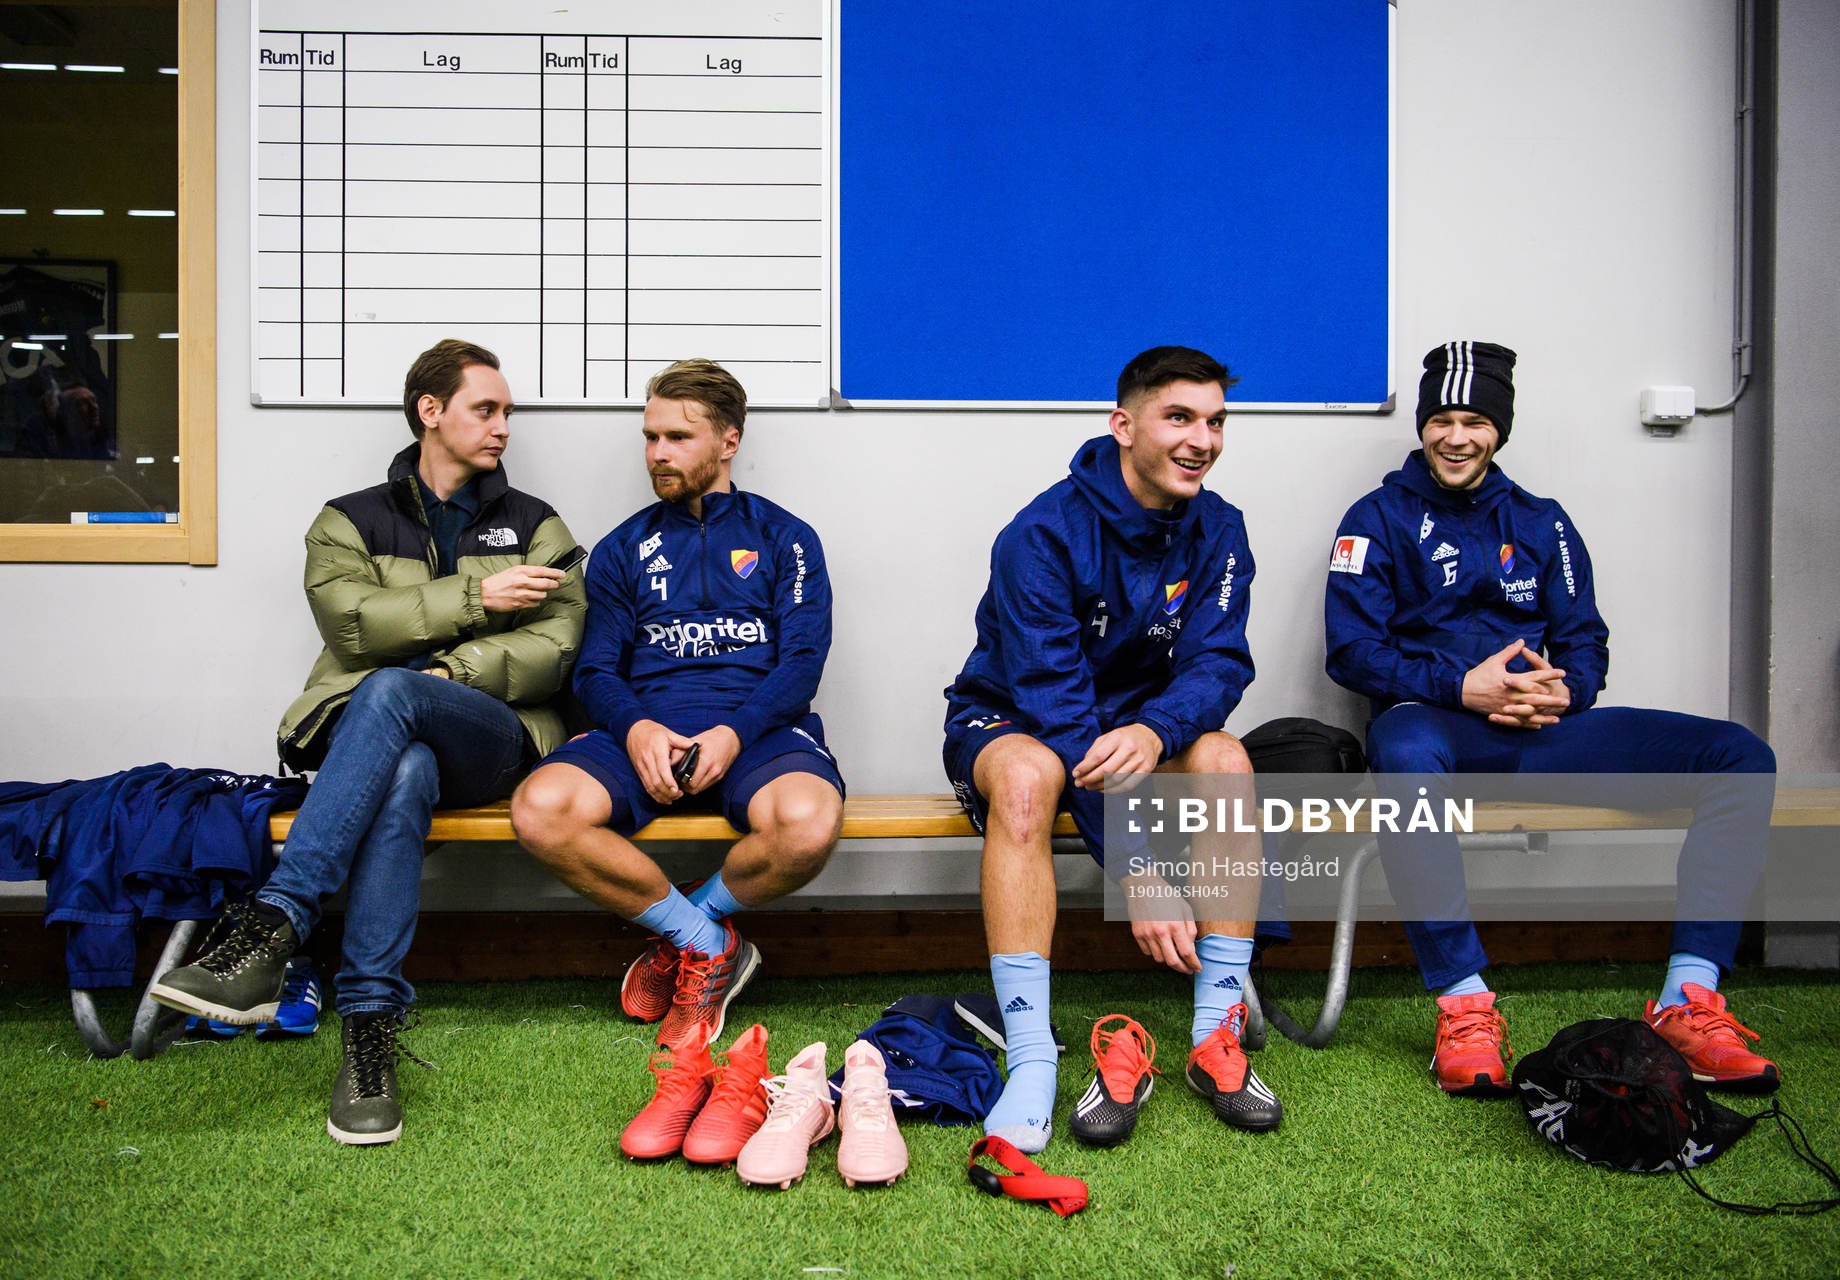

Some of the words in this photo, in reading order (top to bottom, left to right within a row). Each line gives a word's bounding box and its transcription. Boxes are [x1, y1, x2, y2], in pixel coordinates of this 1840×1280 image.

[260, 49, 299, 65] Rum
[306, 50, 335, 65] Tid
[423, 51, 461, 71] Lag
[545, 53, 584, 68] Rum
[588, 53, 618, 68] Tid
[706, 54, 743, 74] Lag
[1431, 548, 1460, 562] adidas
[646, 564, 673, 574] adidas
[1443, 560, 1458, 587] 6
[651, 576, 667, 601] 4
[643, 618, 768, 643] Prioritet
